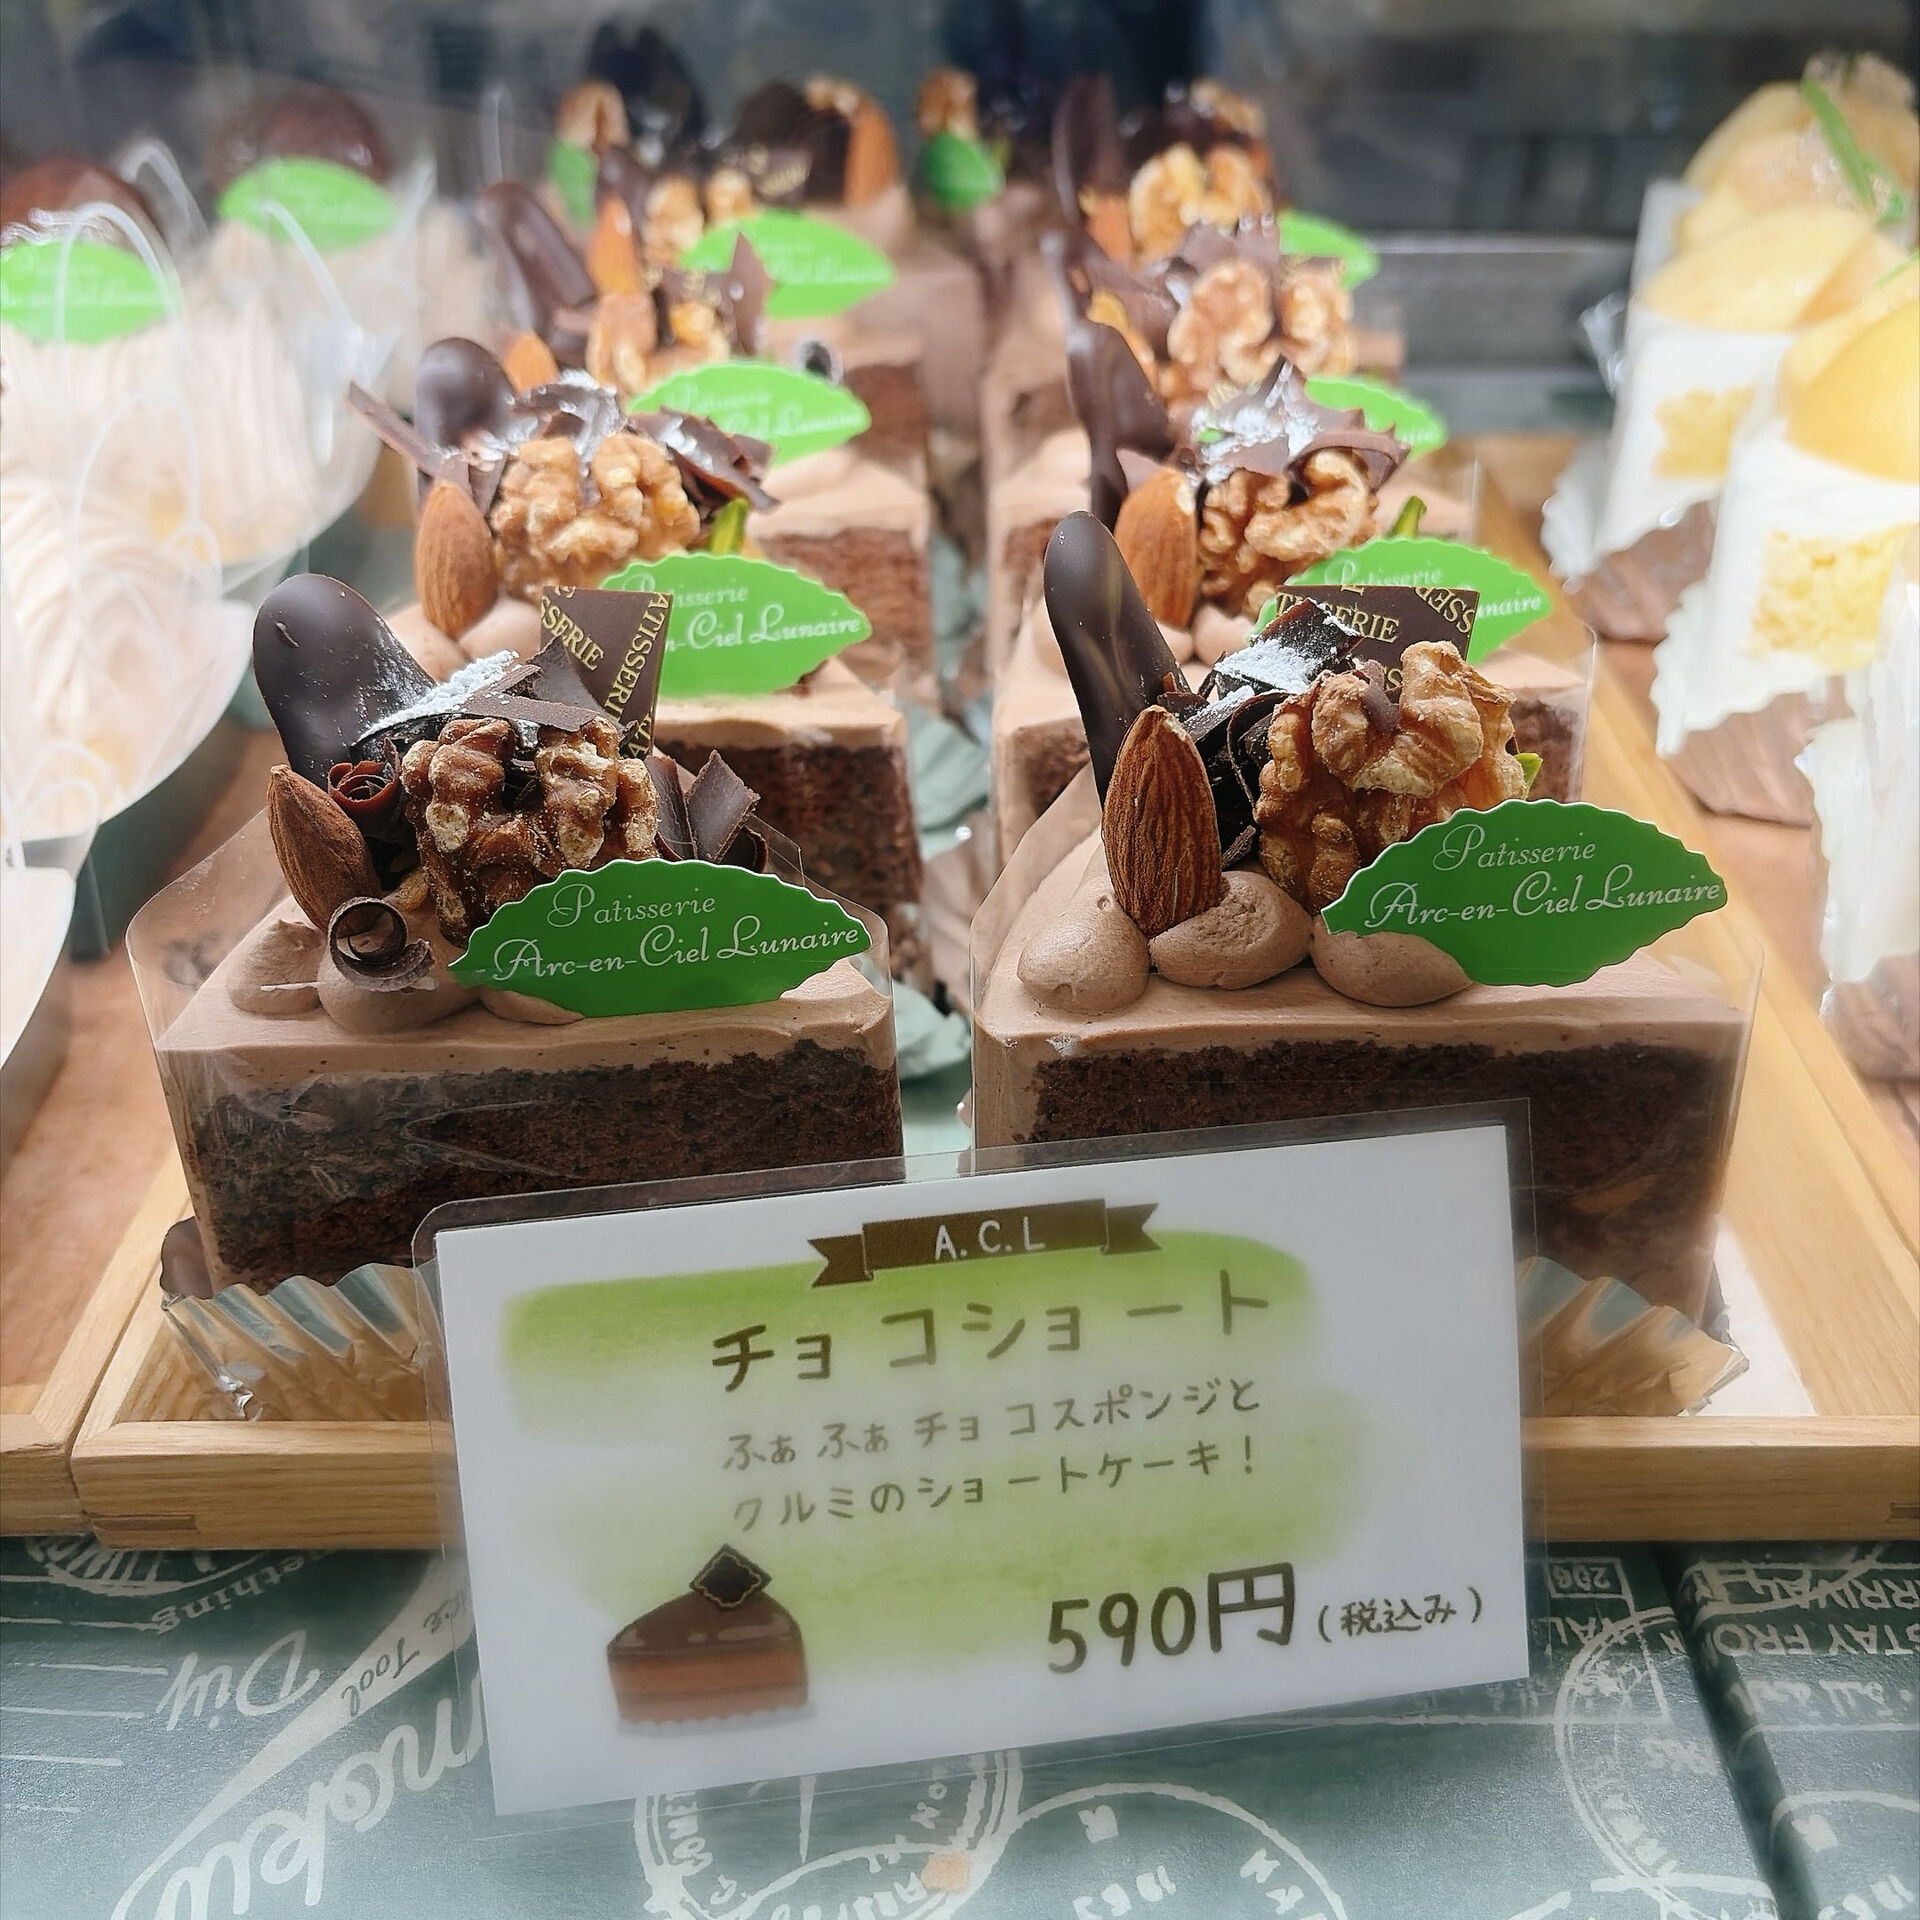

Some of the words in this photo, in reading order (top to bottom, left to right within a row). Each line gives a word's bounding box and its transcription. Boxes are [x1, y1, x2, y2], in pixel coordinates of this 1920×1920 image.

[748, 604, 861, 643] Lunaire
[604, 591, 669, 724] ATISSERI
[1432, 823, 1596, 872] Patisserie
[546, 883, 716, 929] Patisserie
[1363, 870, 1583, 928] Arc-en-Ciel
[1584, 863, 1721, 910] Lunaire
[492, 924, 708, 981] Arc-en-Ciel
[716, 915, 860, 960] Lunaire
[934, 1215, 1047, 1261] A.C.L
[712, 1269, 1270, 1393] チョコショート
[152, 1552, 326, 1636] ething
[1048, 1561, 1297, 1674] 590円
